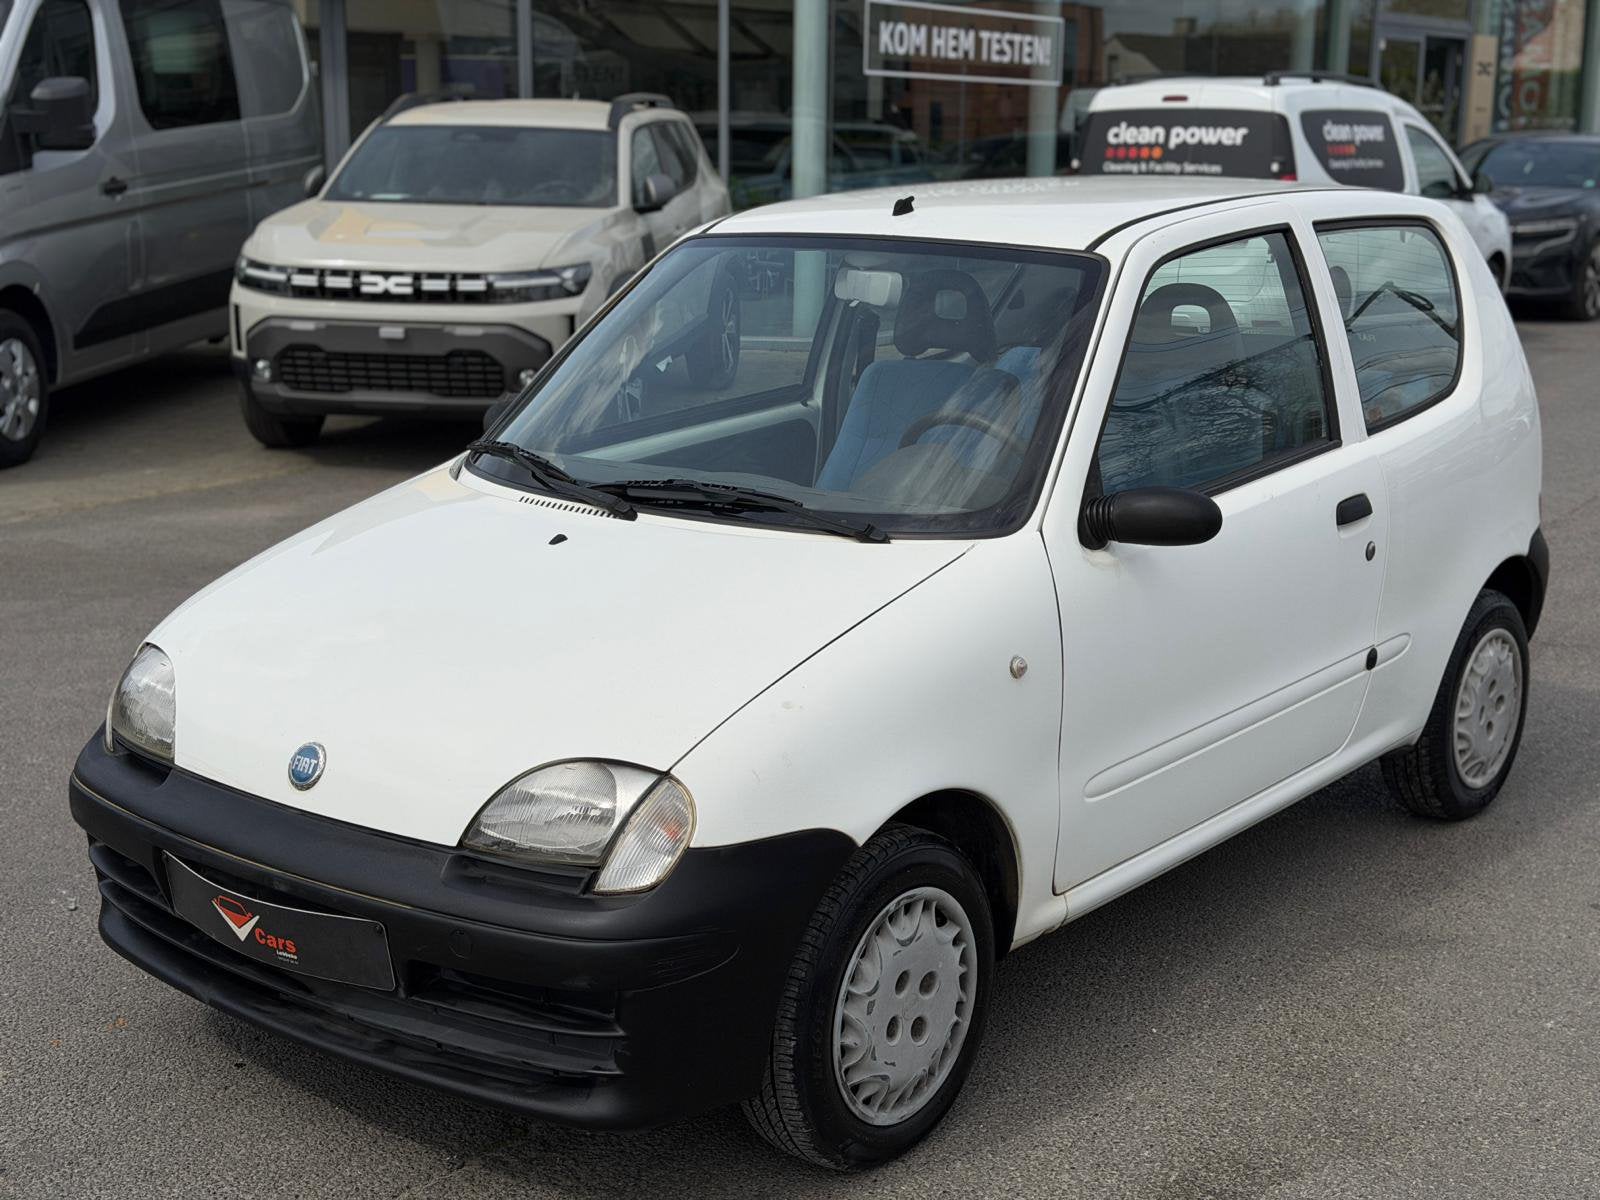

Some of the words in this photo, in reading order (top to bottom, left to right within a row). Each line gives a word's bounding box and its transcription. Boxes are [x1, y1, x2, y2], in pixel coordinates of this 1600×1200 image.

[878, 20, 928, 55] KOM
[931, 25, 976, 60] HEM
[979, 30, 1052, 66] TESTEN!
[1107, 121, 1167, 145] clean
[1167, 126, 1249, 150] power
[292, 755, 318, 774] FIAT
[254, 927, 298, 954] Cars
